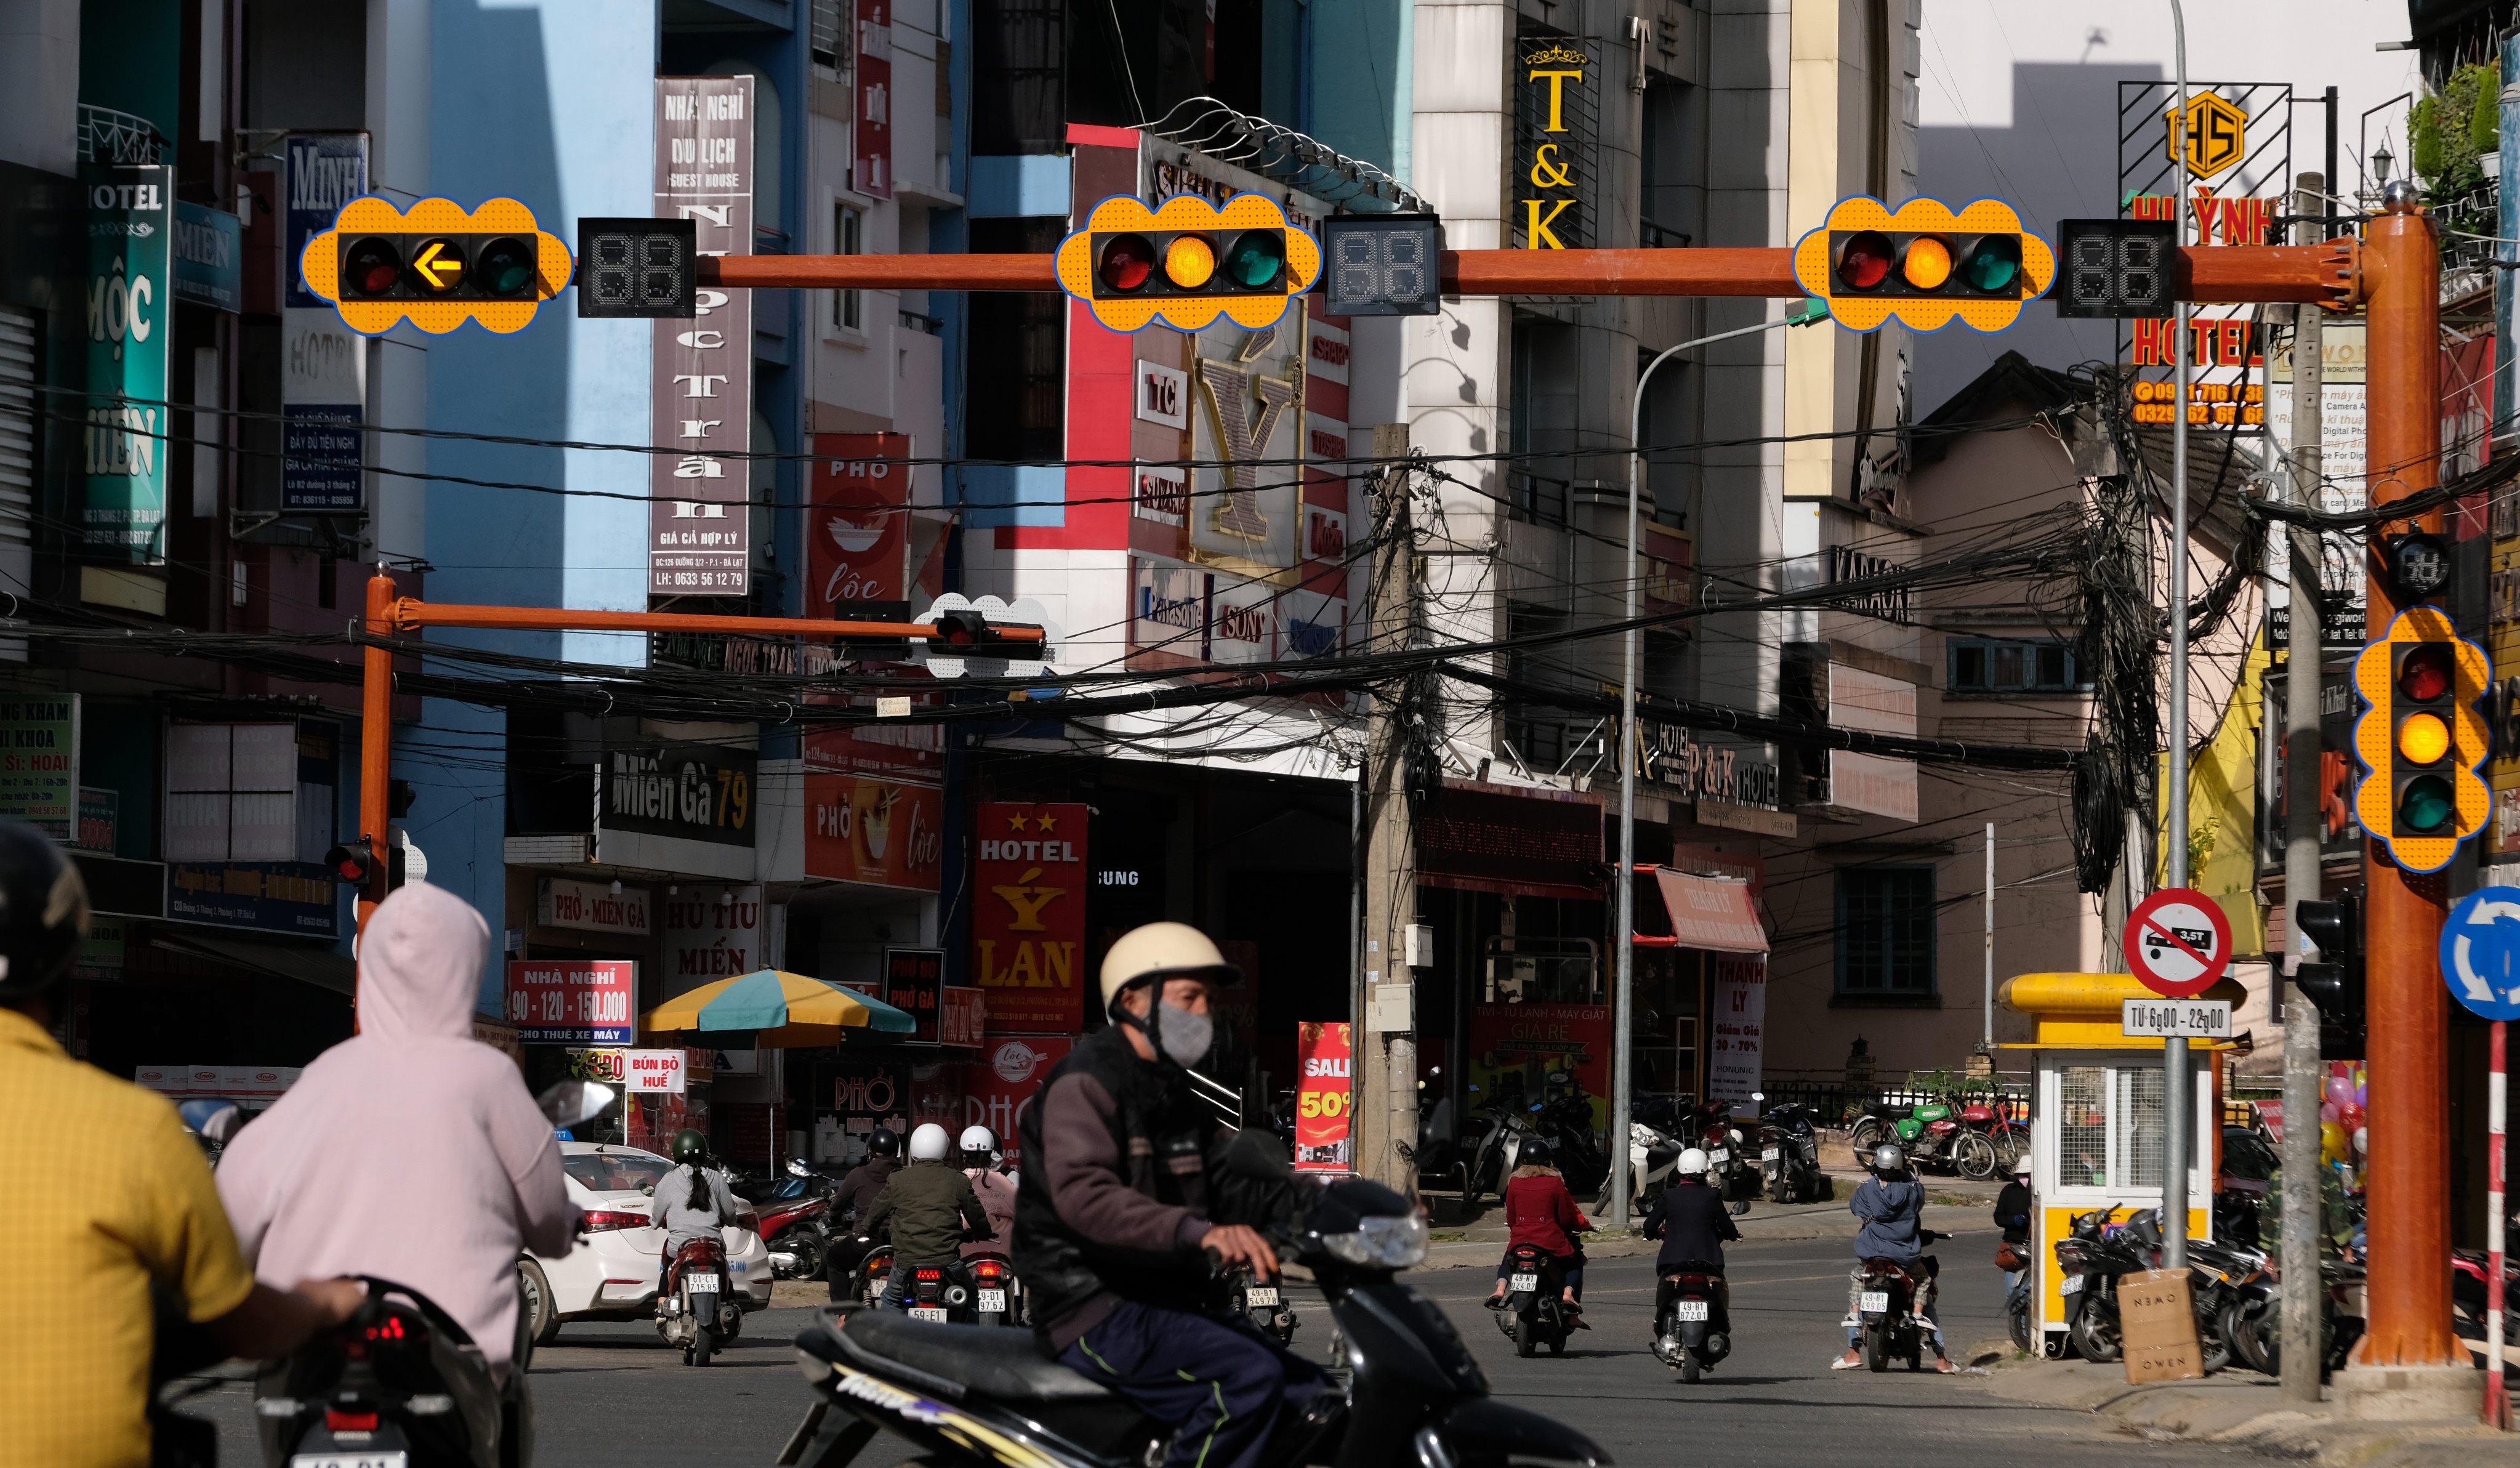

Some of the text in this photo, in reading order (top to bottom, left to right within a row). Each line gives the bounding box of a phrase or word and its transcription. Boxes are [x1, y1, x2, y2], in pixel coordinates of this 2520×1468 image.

[665, 87, 744, 120] NHÀ NGHỈ
[672, 138, 736, 169] DU LỊCH
[670, 173, 739, 187] GUEST HOUSE
[1313, 335, 1349, 365] SHARP
[1151, 374, 1182, 416] TCL
[2200, 383, 2229, 401] 716
[2330, 390, 2354, 401] máy
[2327, 401, 2357, 410] Camera
[2216, 406, 2236, 424] 65
[2323, 427, 2349, 437] Digital
[337, 437, 355, 450] NGHI
[1311, 430, 1347, 459] TOSHIBA
[2335, 451, 2348, 459] For
[660, 530, 738, 547] GIÁ CẢ HỢP LÝ
[656, 573, 743, 586] LH: 0633 56 12 79
[1223, 605, 1266, 643] SONY
[2344, 629, 2357, 640] Tel:
[25, 697, 68, 721] KHÁM
[15, 729, 55, 748] KHOA
[1659, 723, 1689, 757] HOTEL
[31, 751, 68, 771] HOÀI
[1689, 742, 1700, 791] P
[1704, 745, 1720, 794] &
[1723, 749, 1736, 797] K
[618, 751, 747, 829] Miến Gà 79
[817, 792, 852, 839] PHỞ
[981, 839, 1079, 862] HOTEL
[992, 866, 1067, 931] Ý
[1685, 887, 1719, 911] THANH
[555, 887, 646, 929] PHỞ GÀ
[667, 891, 758, 929] HỦ TÍU
[2180, 930, 2205, 942] 3,5T
[678, 936, 746, 975] MIẾN
[978, 939, 1077, 988] LAN
[524, 967, 616, 985] NHÀ NGHỈ
[1718, 961, 1765, 984] THANH
[891, 985, 935, 1009] PHỞ GÀ
[1732, 984, 1748, 1012] LÝ
[512, 991, 627, 1022] 90 120 150.000
[1477, 1006, 1606, 1022] TIVI TỦ LẠNH MÁY GIẶT
[944, 991, 969, 1043] PHỞ BÒ
[2132, 1003, 2146, 1028] TỪ
[2149, 1007, 2177, 1033] 6g00
[2189, 1008, 2224, 1034] 22g00
[517, 1028, 620, 1041] CHO THUÊ XE MÁY
[1511, 1020, 1569, 1041] GIÁ RẺ
[1716, 1023, 1760, 1036] Giảm Giá
[1716, 1039, 1758, 1052] 30 70%
[632, 1055, 658, 1070] BÚN
[661, 1055, 679, 1070] BÒ
[1717, 1065, 1754, 1075] HONUNIC
[643, 1071, 668, 1087] HUẾ
[835, 1067, 895, 1111] PHỞ
[819, 1114, 874, 1136] TÁI NẠM
[693, 1275, 714, 1283] 61-C1
[1510, 1281, 1536, 1291] 024.07
[1515, 1273, 1534, 1282] 49-N1
[690, 1283, 717, 1292] 715.85
[1251, 1289, 1273, 1297] 49-B1
[1249, 1297, 1277, 1305] 549.78
[1683, 1302, 1704, 1311] 49-B1
[1861, 1301, 1886, 1310] 499.05
[1864, 1293, 1885, 1302] 49-B1
[2133, 1293, 2176, 1308] OWEN
[914, 1310, 941, 1321] 59-E1
[1680, 1311, 1706, 1320] 872.01
[2141, 1357, 2186, 1370] OWEN
